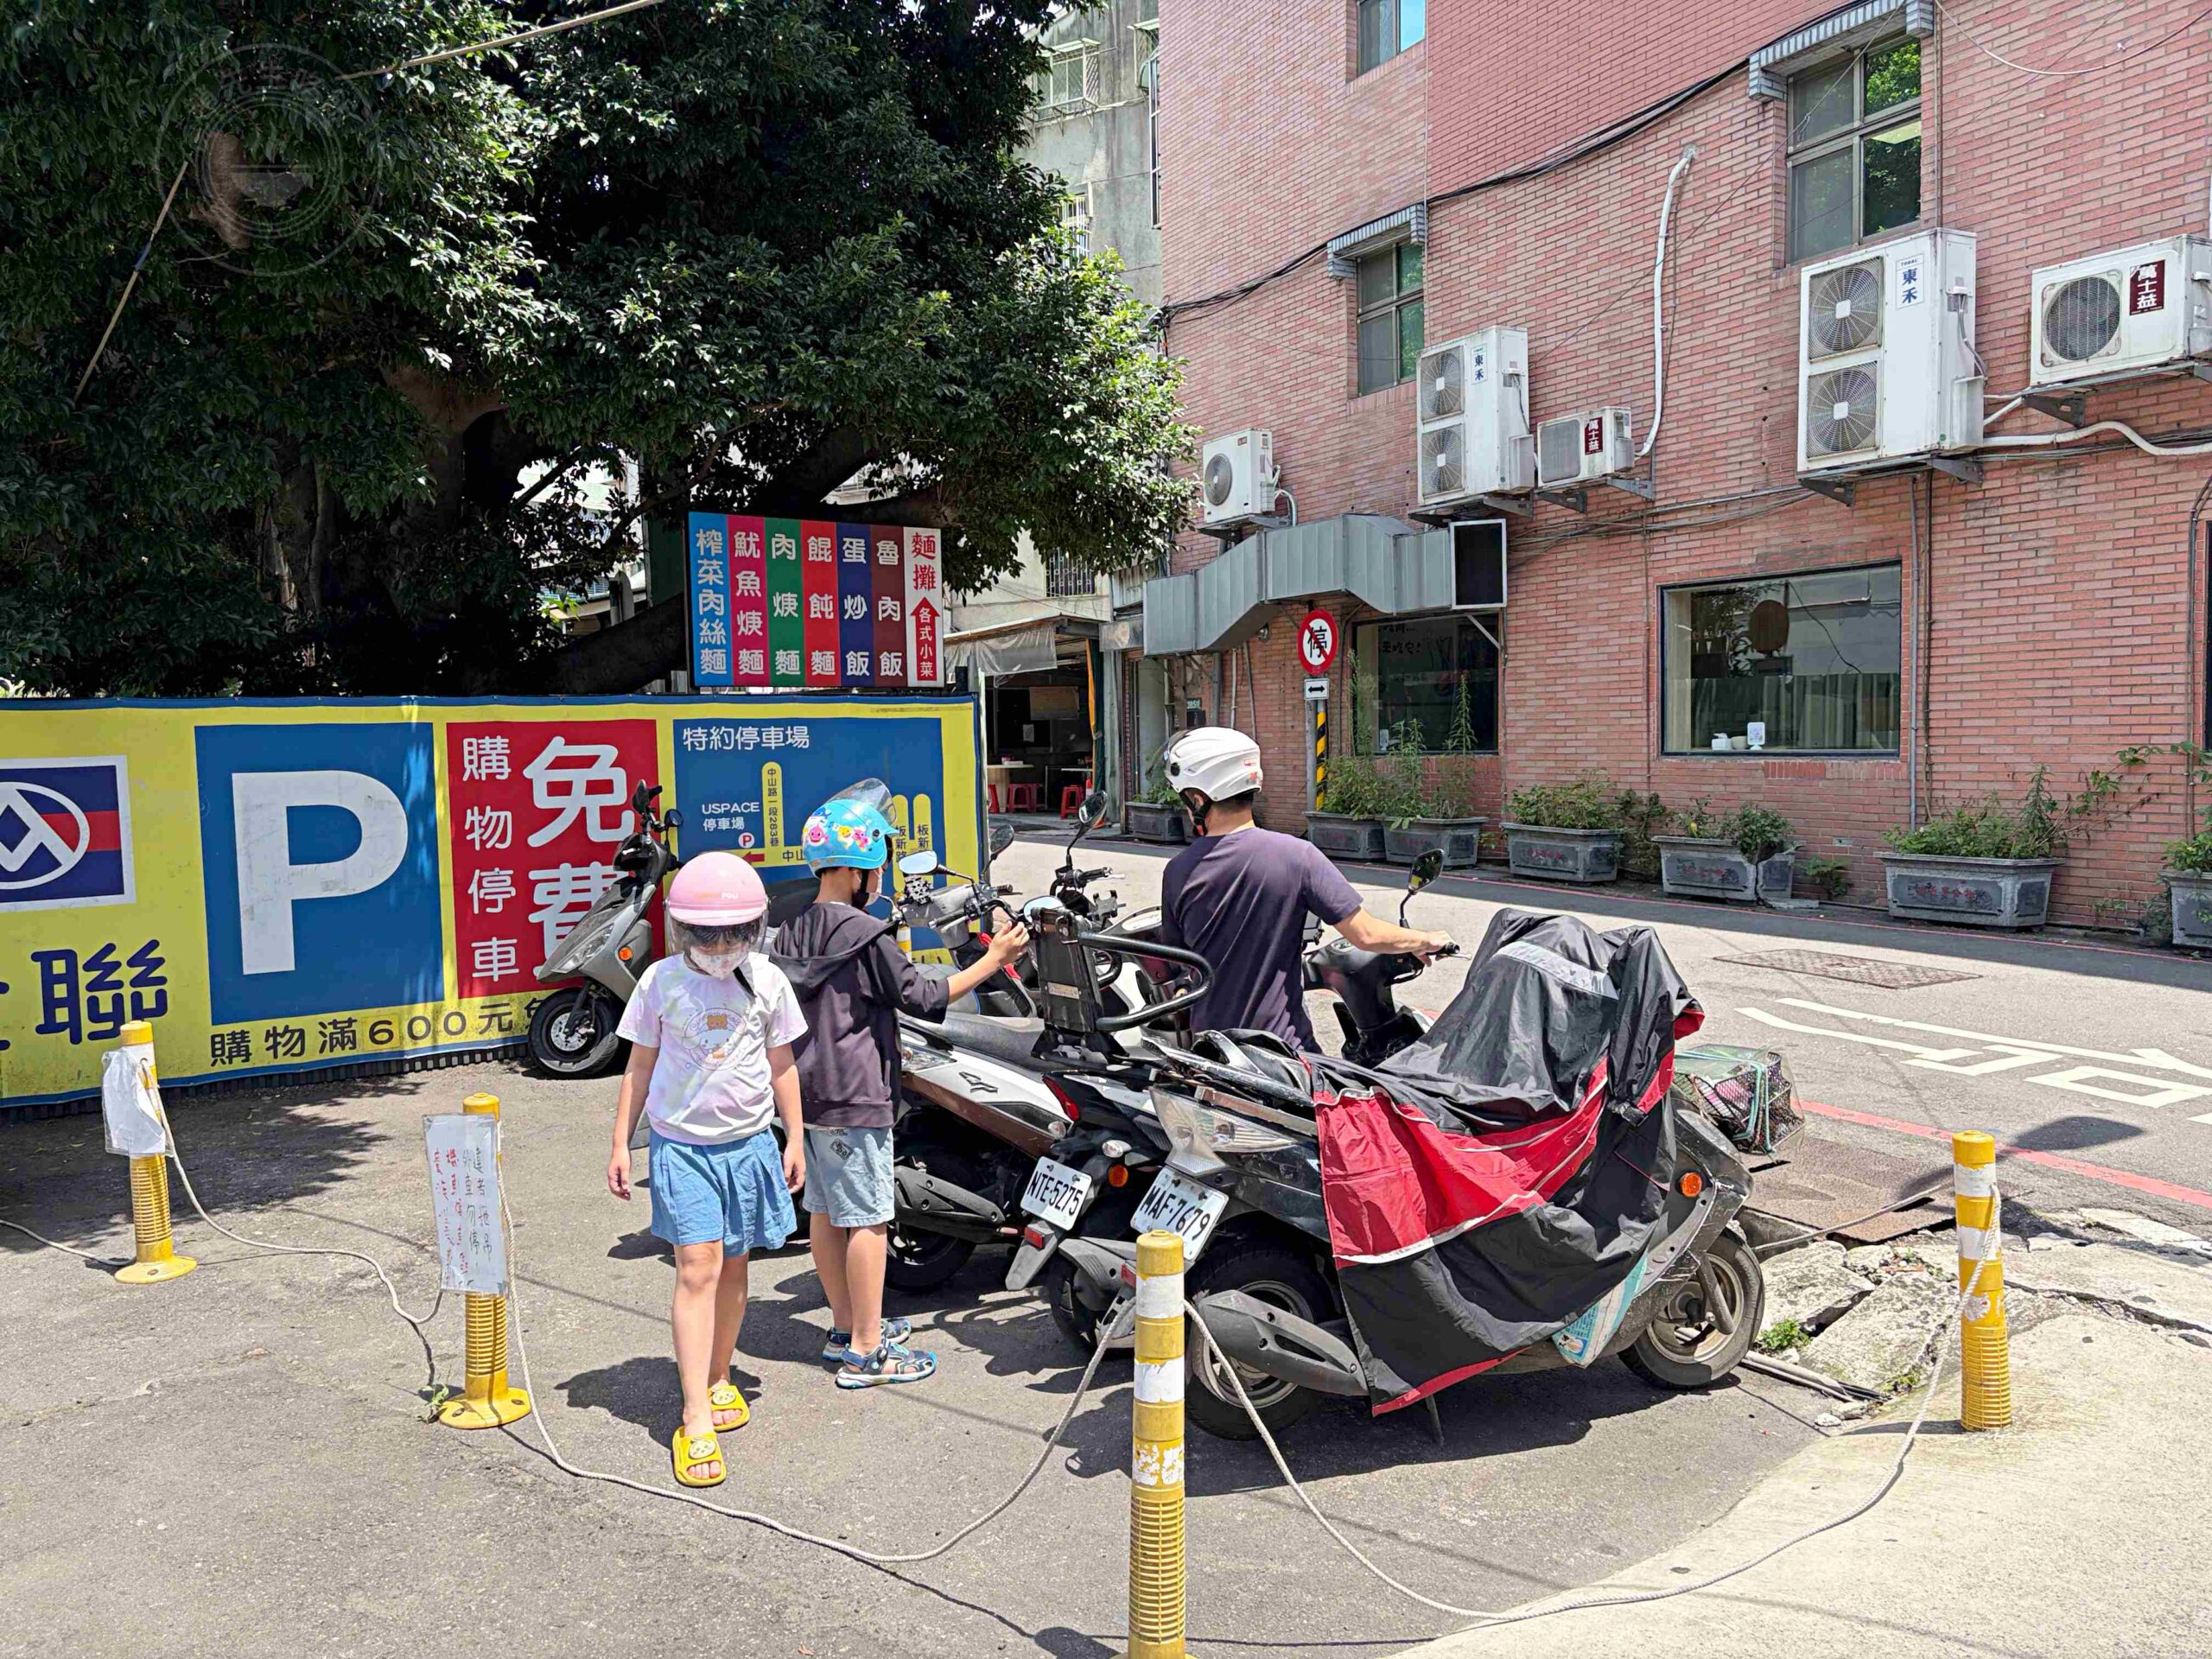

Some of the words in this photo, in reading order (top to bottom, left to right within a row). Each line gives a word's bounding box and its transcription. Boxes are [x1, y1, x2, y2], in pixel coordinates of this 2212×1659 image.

[911, 532, 937, 592] 麵攤
[696, 529, 728, 675] 榨菜肉絲麵
[806, 536, 836, 677] 餛飩麵
[842, 537, 870, 677] 蛋炒飯
[875, 539, 904, 677] 魯肉飯
[918, 607, 933, 677] 各式小菜
[1307, 626, 1327, 658] 停
[683, 725, 810, 752] 特約停車場
[702, 802, 760, 815] USPACE
[702, 817, 745, 831] 停車場
[918, 823, 930, 852] 板新
[231, 769, 409, 976] P
[462, 735, 520, 982] 購物停車
[0, 939, 168, 1052] 聯
[1027, 1171, 1084, 1216] NTE-5275
[1139, 1185, 1211, 1242] MAF-7679
